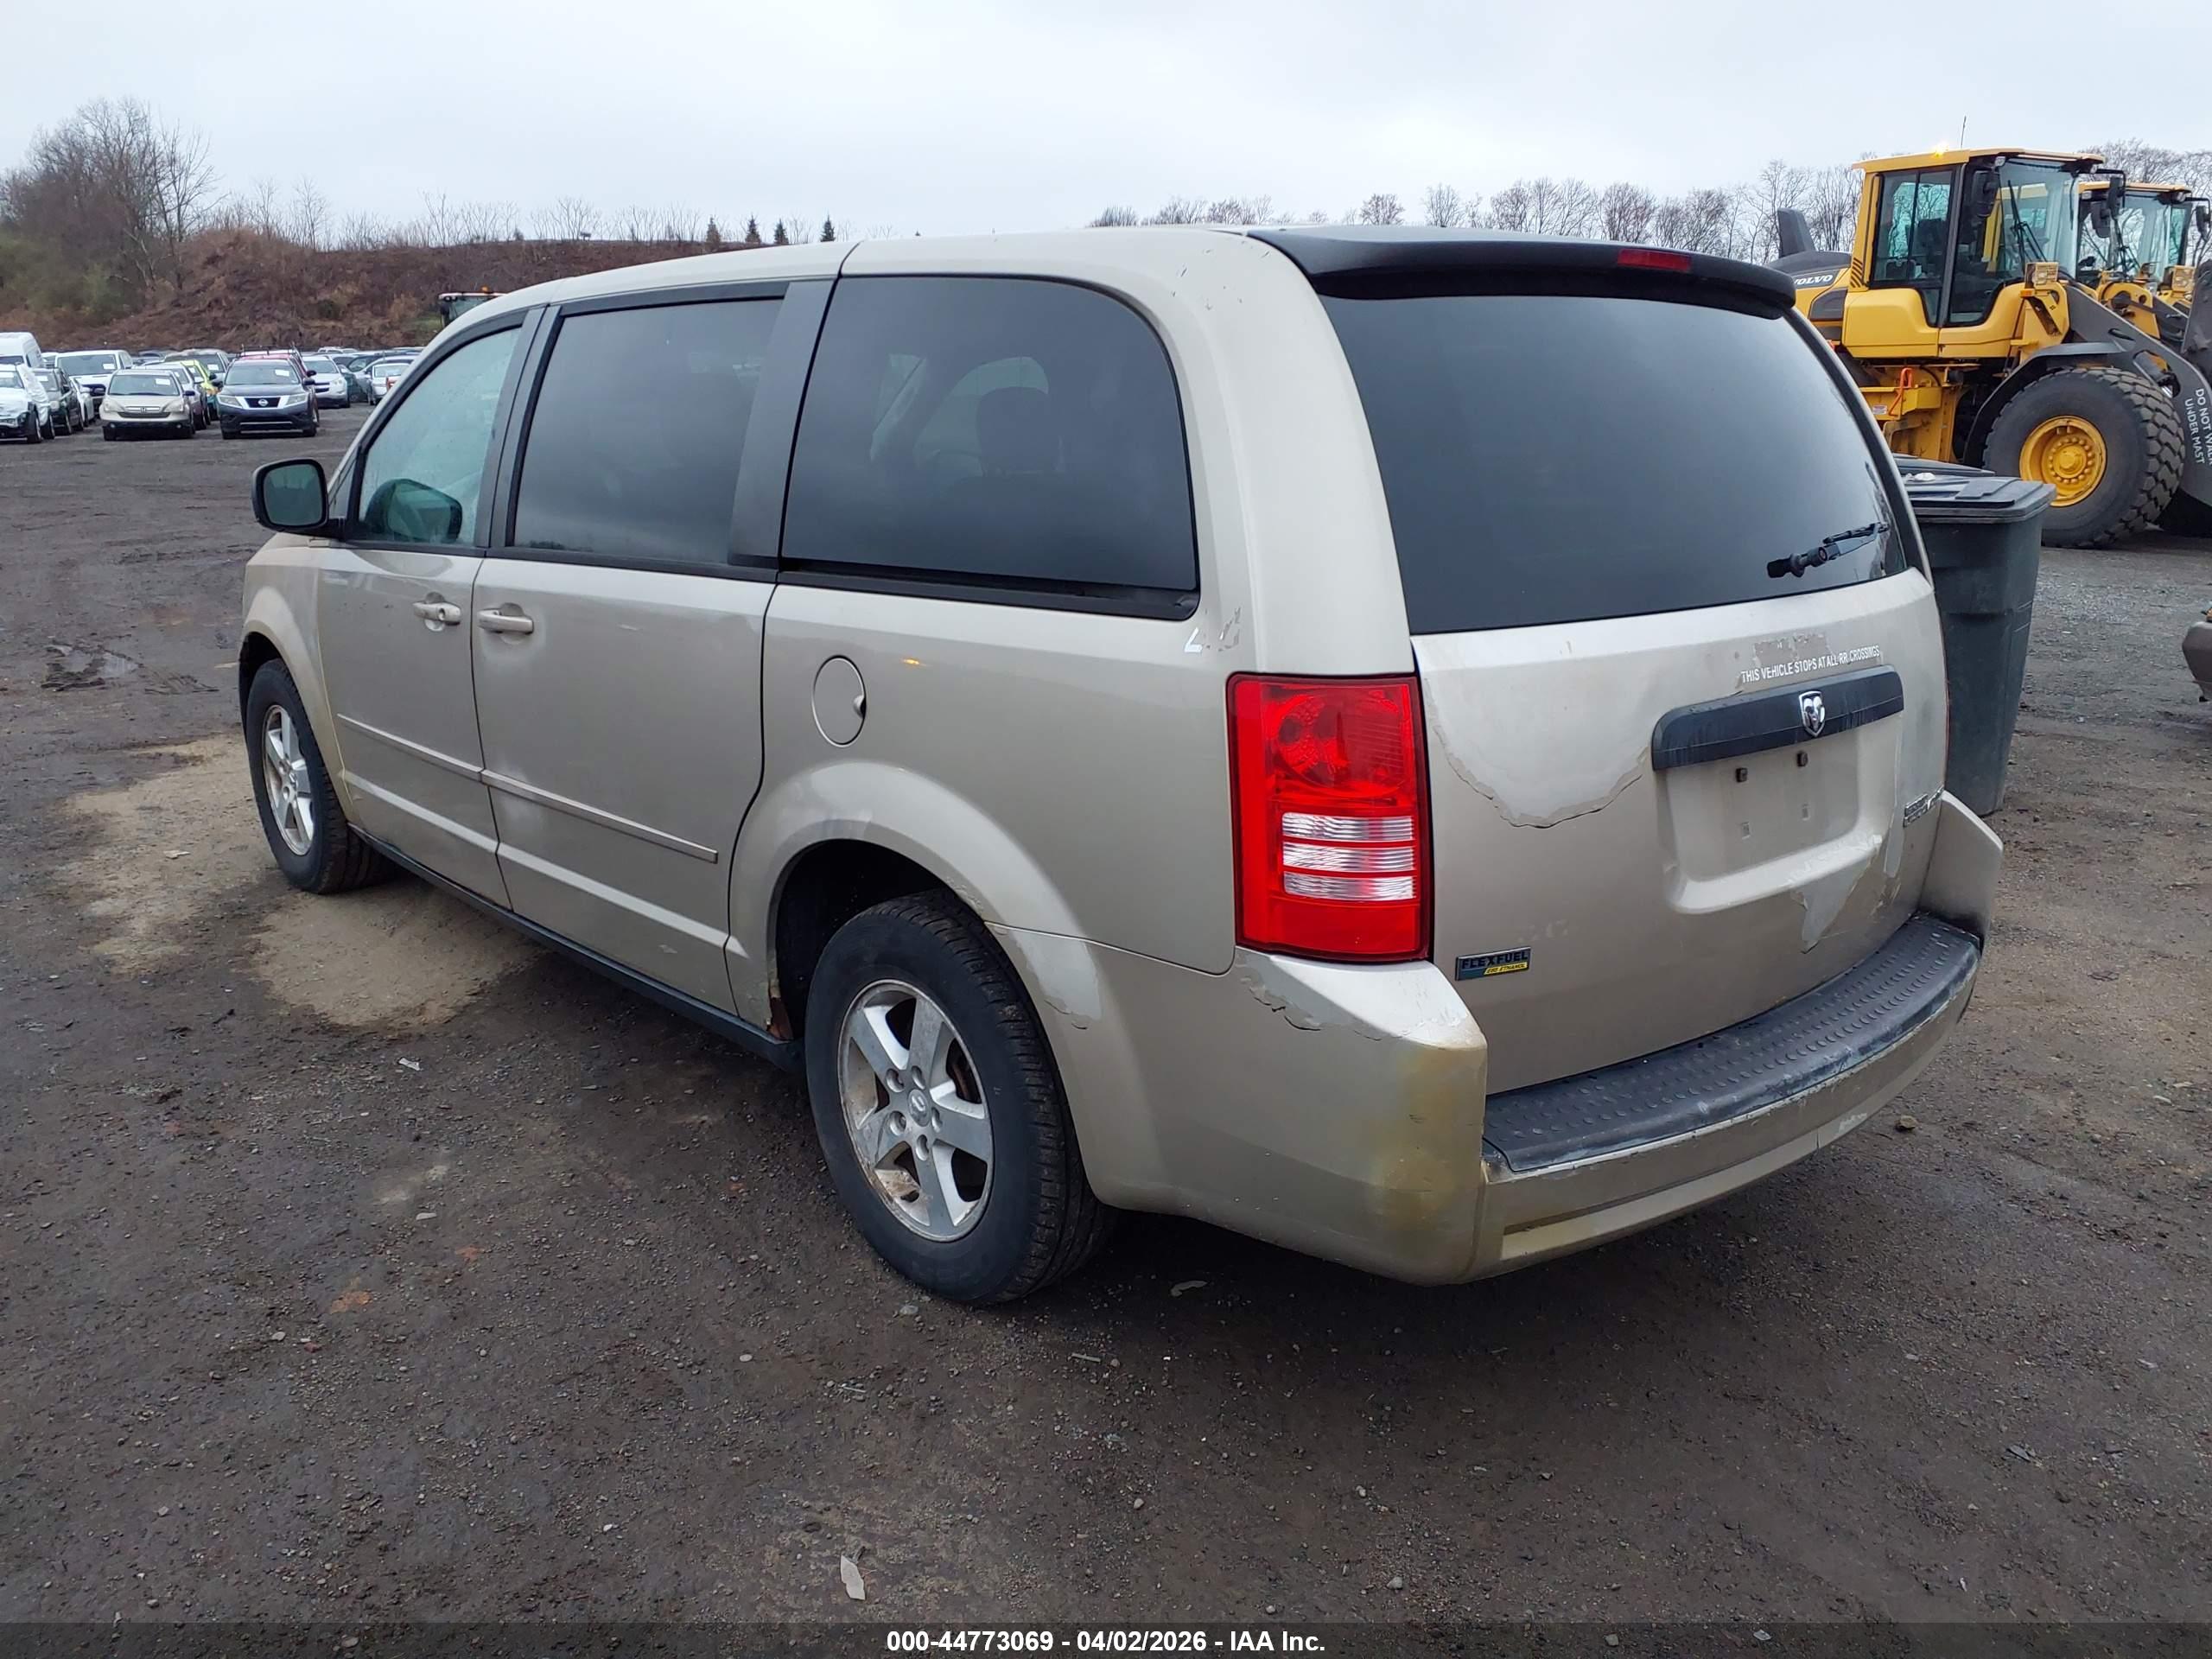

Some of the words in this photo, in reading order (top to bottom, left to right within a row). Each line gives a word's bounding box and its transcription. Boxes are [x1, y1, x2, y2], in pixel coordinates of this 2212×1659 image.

[2196, 389, 2206, 404] DO
[2185, 398, 2199, 435] UNDER
[2193, 436, 2205, 464] MAST
[2200, 408, 2211, 430] NOT
[1741, 669, 1760, 683] THIS
[1761, 662, 1793, 679] VEHICLE
[1794, 658, 1817, 674] STOPS
[1818, 657, 1826, 669] AT
[1826, 655, 1839, 667] ALL
[1849, 645, 1880, 662] CROSSINGS
